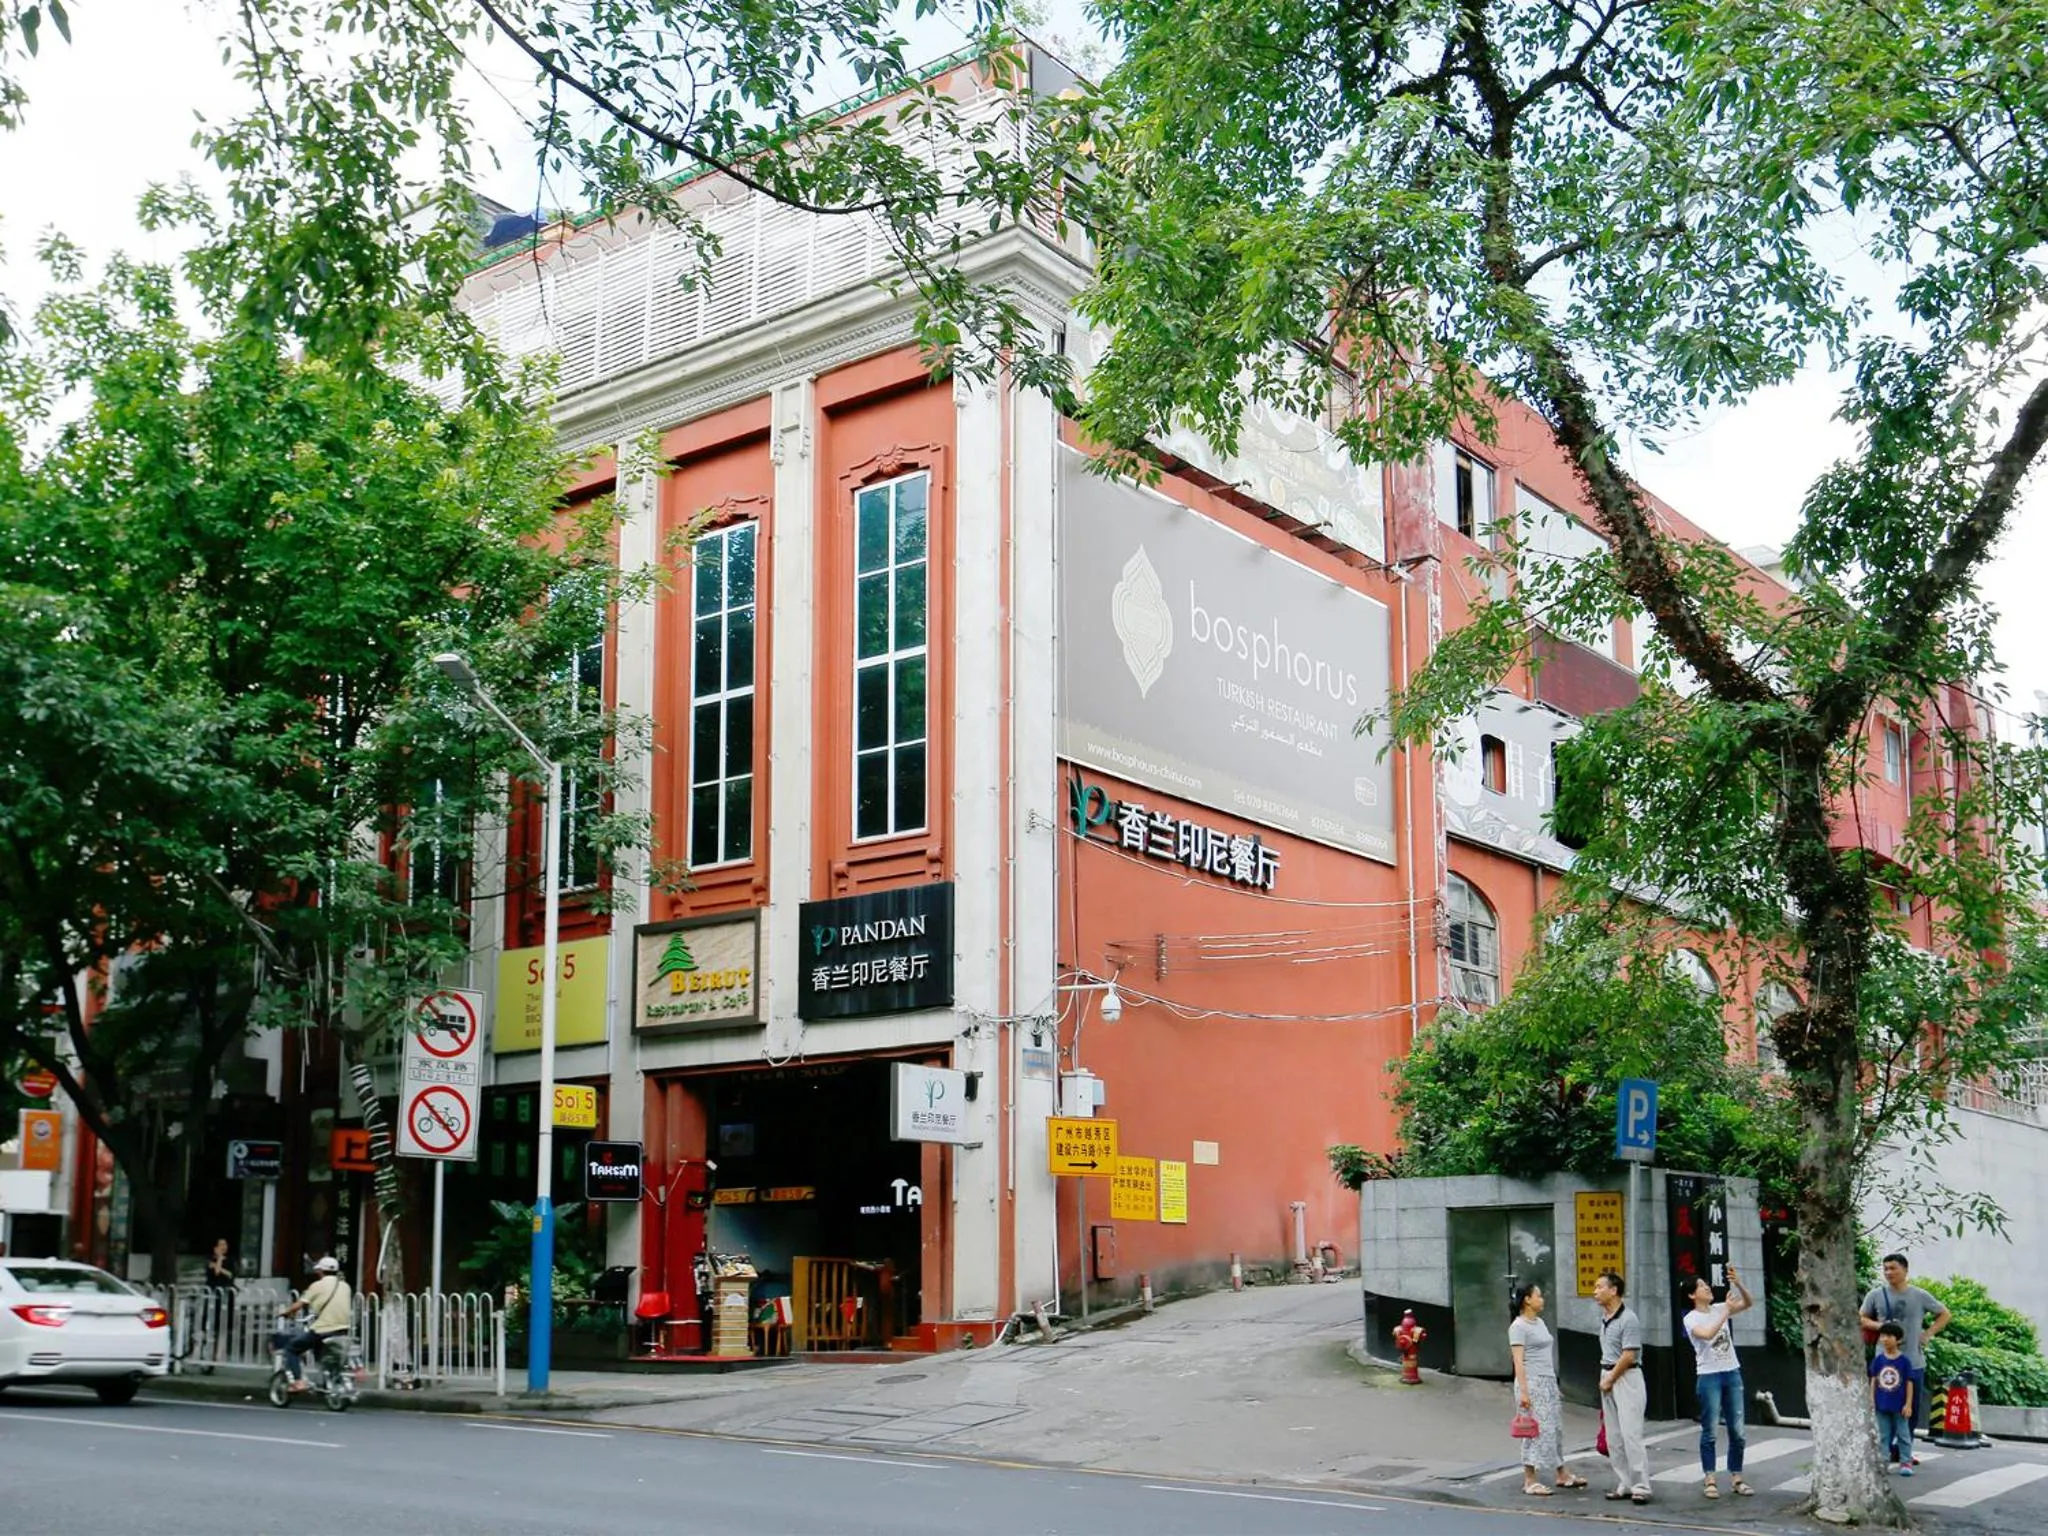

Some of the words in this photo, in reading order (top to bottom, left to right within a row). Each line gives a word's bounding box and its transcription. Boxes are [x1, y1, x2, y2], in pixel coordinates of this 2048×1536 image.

[1190, 579, 1357, 706] bosphorus
[1217, 677, 1265, 713] TURKISH
[1267, 698, 1339, 742] RESTAURANT
[1118, 802, 1280, 890] 香兰印尼餐厅
[841, 915, 927, 946] PANDAN
[563, 953, 576, 980] 5
[671, 968, 751, 996] BEIRUT
[811, 953, 930, 992] 香兰印尼餐厅
[554, 1089, 580, 1110] Soi
[585, 1091, 594, 1110] 5
[1628, 1089, 1649, 1138] P
